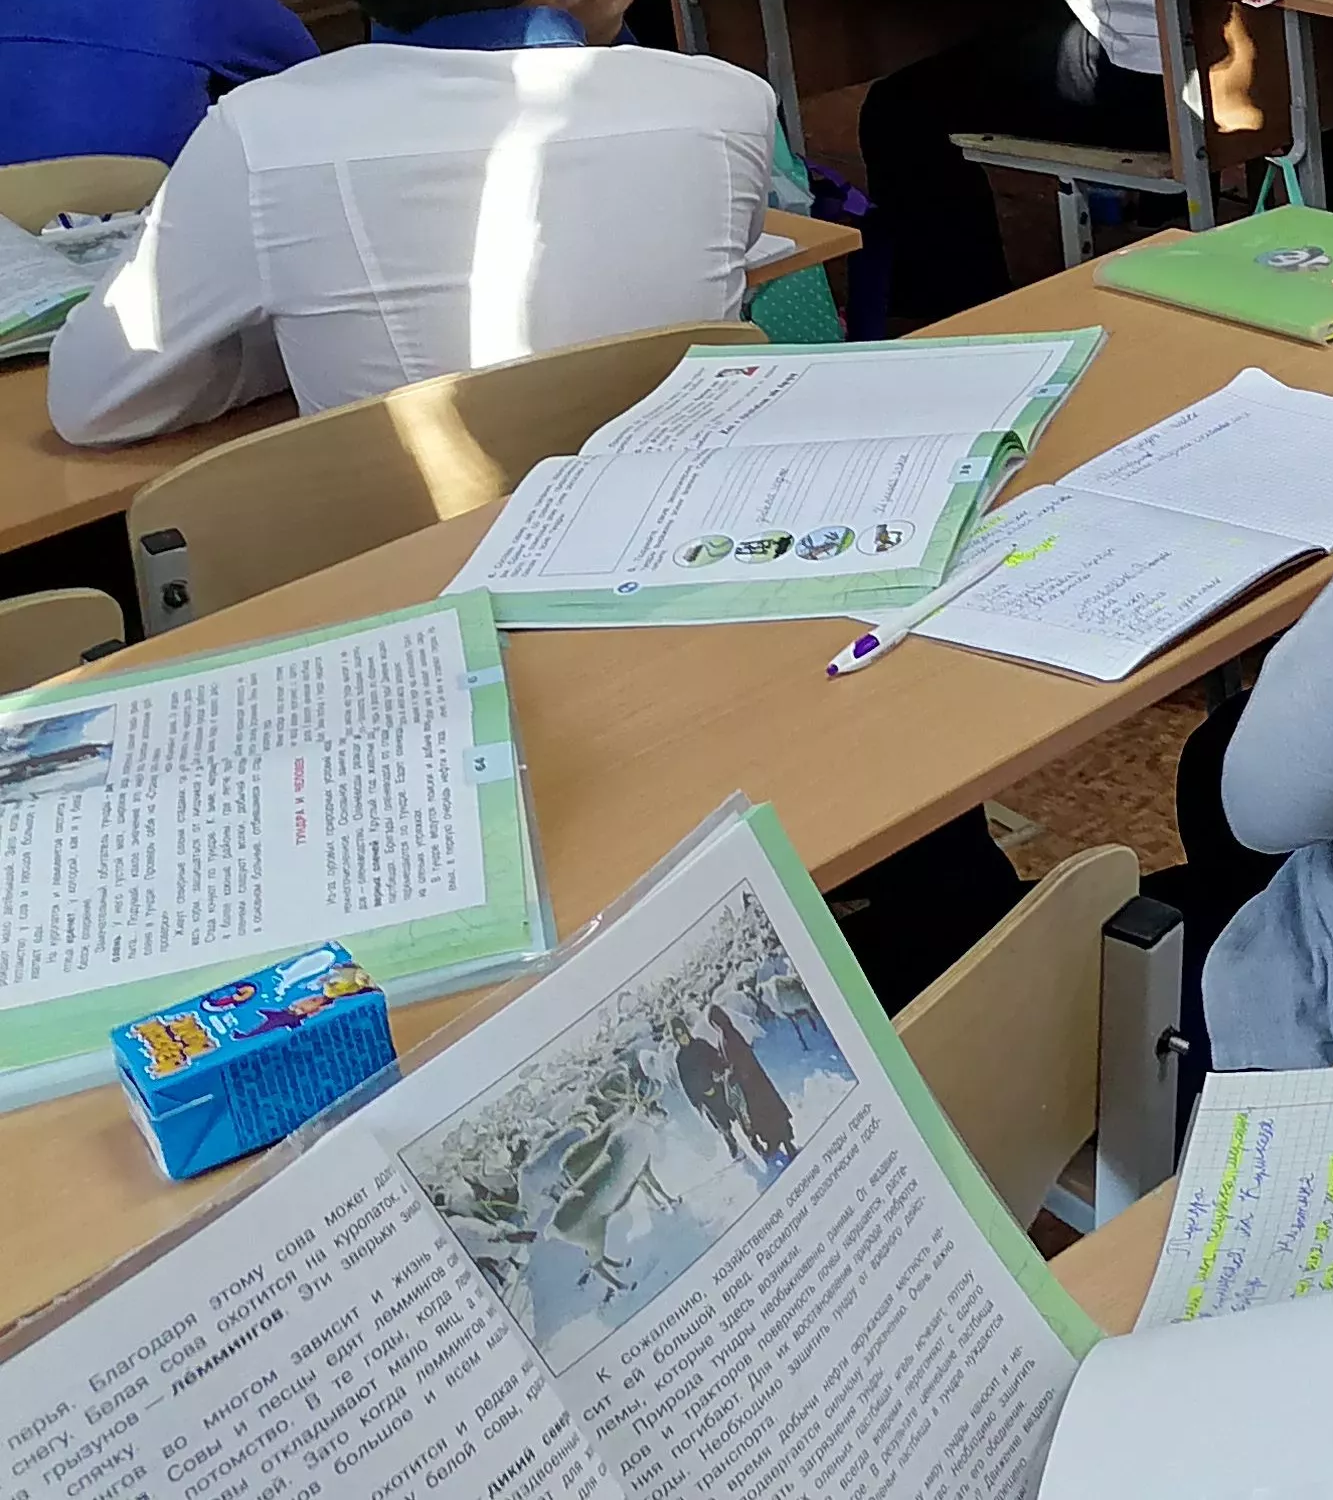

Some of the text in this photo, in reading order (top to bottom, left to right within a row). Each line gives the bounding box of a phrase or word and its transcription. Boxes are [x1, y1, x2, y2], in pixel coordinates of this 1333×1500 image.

[294, 755, 306, 846] ТУНДРА И ЧЕЛОВЕК
[40, 1220, 399, 1488] грызунов Эти зверьки
[81, 1370, 151, 1426] Белая
[156, 1332, 209, 1375] сова
[213, 1267, 299, 1334] охотится
[301, 1245, 328, 1270] на
[86, 1186, 370, 1396] Благодаря этому сова может
[158, 1248, 433, 1460] во многом зависит и жизнь
[580, 1391, 614, 1424] сит
[620, 1366, 646, 1392] ей
[649, 1301, 718, 1366] большой
[752, 1205, 812, 1267] Рассмотрим
[593, 1207, 786, 1385] К сожалению, хозяйственное
[163, 1264, 447, 1485] Совы и песцы едят леммингов
[180, 1287, 455, 1500] потомство. В те годы, когда
[257, 1375, 382, 1475] откладывают
[385, 1335, 430, 1378] мало
[433, 1307, 466, 1339] яиц,
[300, 1314, 489, 1472] Зато когда леммингов
[330, 1350, 483, 1477] большое и всем
[367, 1371, 521, 1500] охотится и редкая
[592, 1392, 649, 1441] лемы,
[652, 1333, 718, 1394] которые
[716, 1293, 756, 1334] здесь
[615, 1283, 817, 1477] дов и тракторов поверхность
[628, 1458, 664, 1492] ния
[743, 1357, 774, 1391] Для
[773, 1340, 792, 1360] их
[629, 1370, 706, 1436] Природа
[709, 1320, 758, 1370] тундры
[696, 1321, 833, 1461] Необходимо защитить
[724, 1354, 852, 1493] время добычи нефти
[794, 1403, 859, 1481] загрязнения
[821, 1364, 867, 1420] сильному
[421, 1401, 524, 1490] белой совы,
[811, 1439, 855, 1490] оленьих
[836, 1446, 872, 1491] всегда
